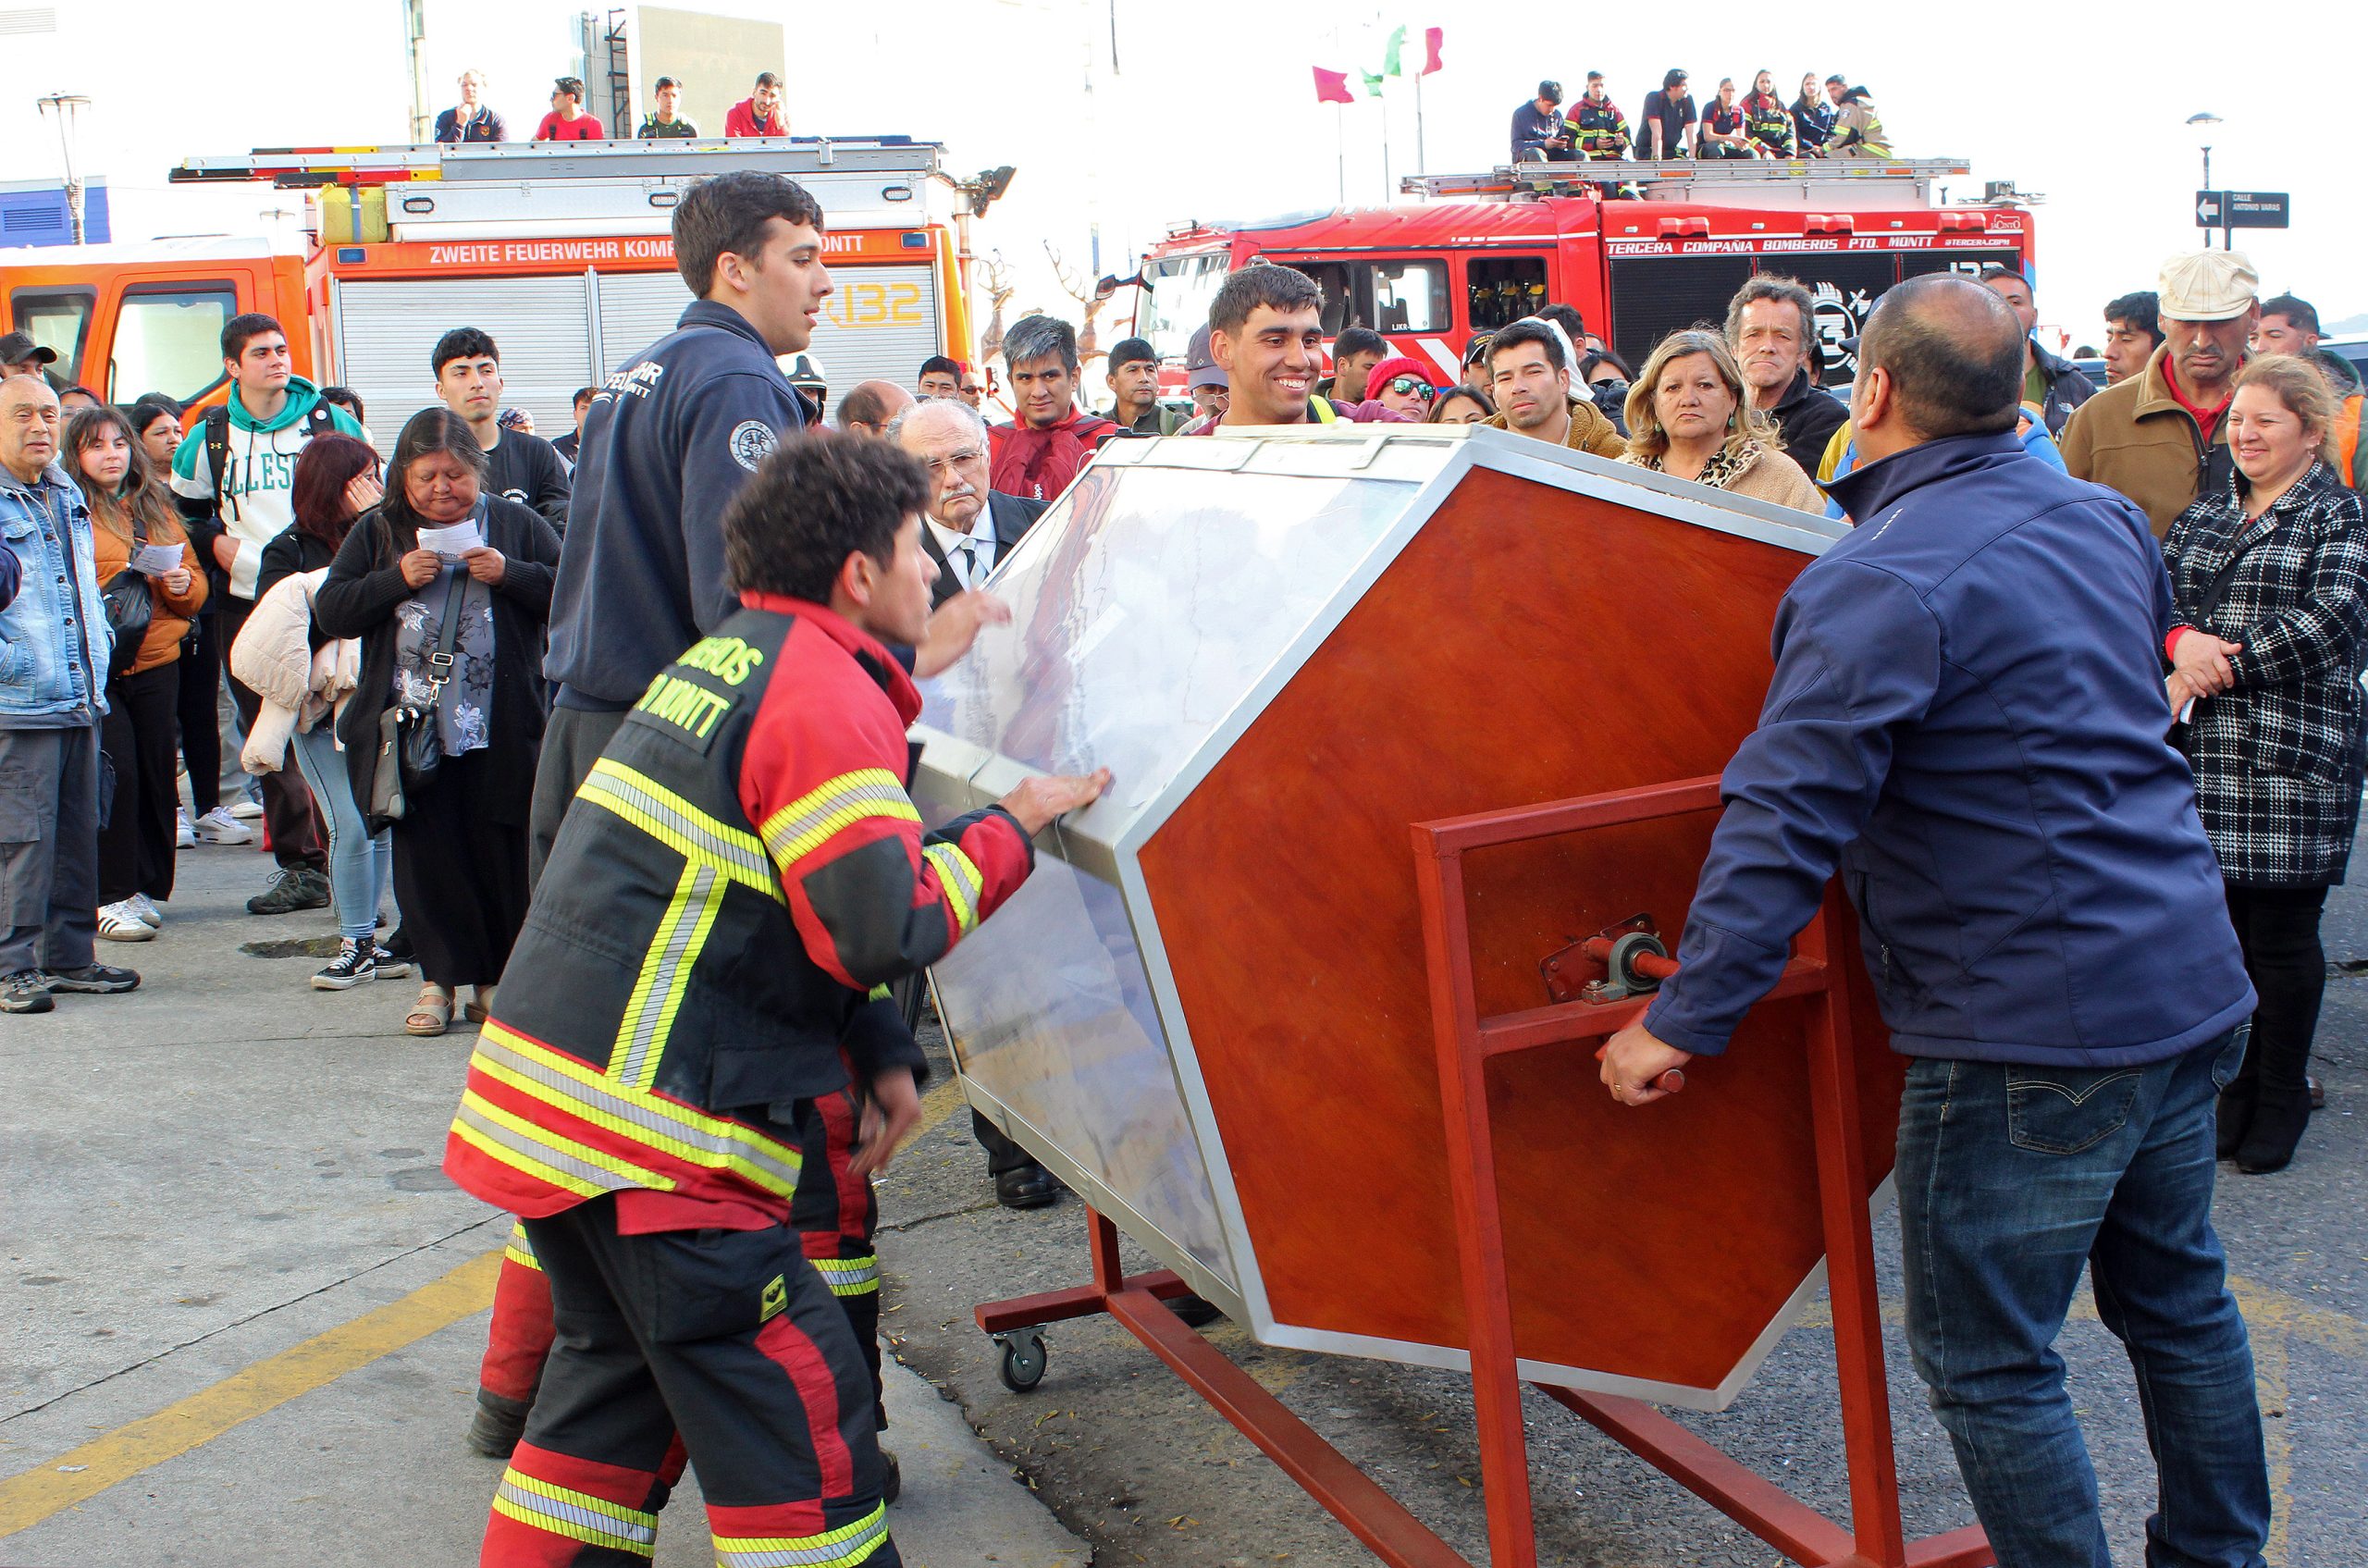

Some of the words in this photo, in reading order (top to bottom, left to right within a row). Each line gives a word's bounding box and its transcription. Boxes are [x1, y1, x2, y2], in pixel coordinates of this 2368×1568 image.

[430, 244, 500, 264] ZWEITE
[505, 241, 620, 261] FEUERWEHR
[1607, 241, 1673, 254] TERCERA
[1683, 240, 1754, 253] COMPAÑIA
[1762, 239, 1838, 251] BOMBEROS
[1848, 238, 1880, 249] PTO.
[1888, 236, 1935, 248] MONTT
[844, 282, 922, 323] 132
